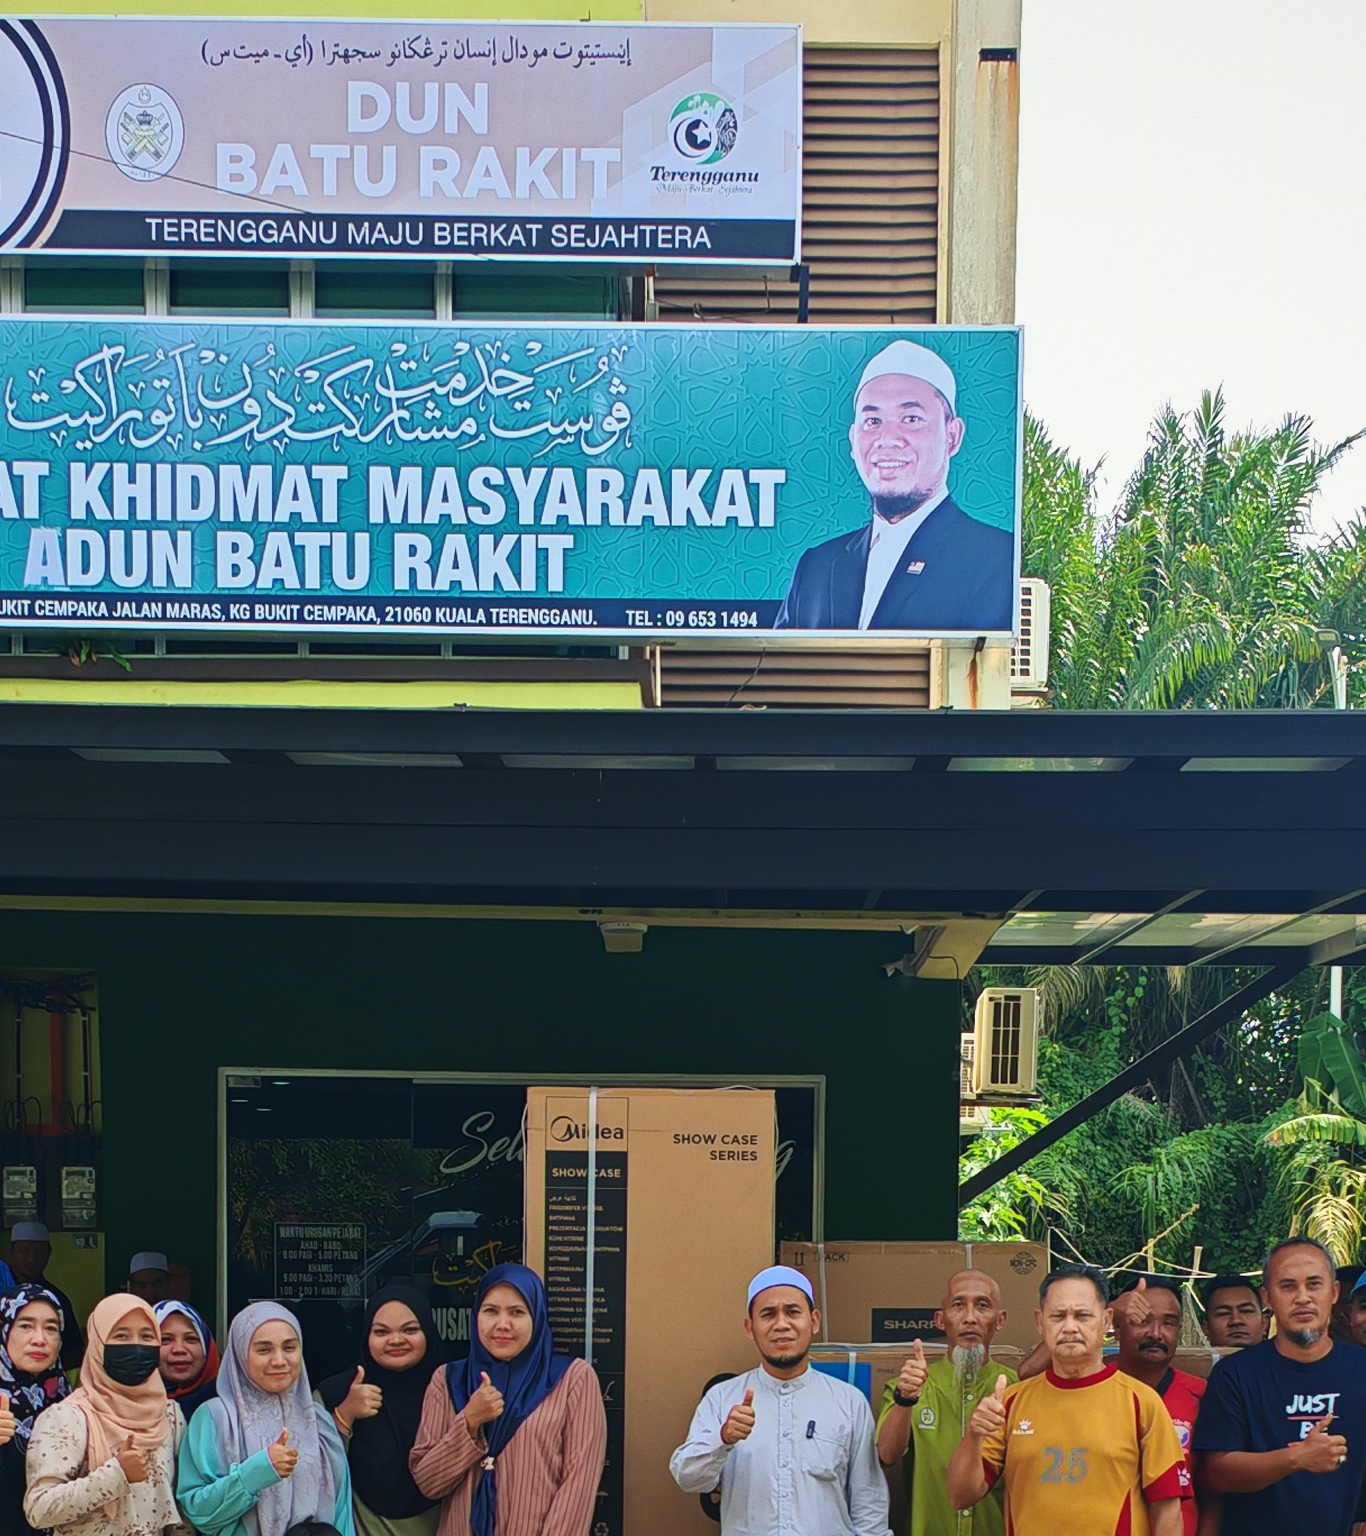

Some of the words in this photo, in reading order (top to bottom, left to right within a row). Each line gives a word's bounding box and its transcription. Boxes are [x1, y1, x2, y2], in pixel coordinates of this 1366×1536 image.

[348, 81, 489, 135] DUN
[215, 143, 399, 198] BATU
[419, 146, 622, 200] RAKIT
[650, 165, 760, 185] Terengganu
[145, 217, 337, 245] TERENGGANU
[347, 222, 425, 247] MAJU
[434, 223, 543, 248] BERKAT
[550, 224, 712, 250] SEJAHTERA
[69, 461, 349, 523] KHIDMAT
[369, 465, 786, 527] MASYARAKAT
[23, 527, 193, 588] ADUN
[215, 530, 371, 590] BATU
[393, 533, 574, 592] RAKIT
[34, 600, 109, 617] CEMPAKA
[112, 601, 163, 619] JALAN
[166, 602, 226, 621] MARAS,
[229, 603, 251, 620] KG
[254, 604, 299, 621] BUKIT
[303, 605, 381, 625] CEMPAKA,
[384, 606, 432, 624] 21060
[435, 607, 486, 625] KUALA
[490, 608, 598, 627] TERENGGANU.
[625, 610, 654, 627] TEL
[665, 610, 686, 627] 09
[688, 611, 717, 628] 653
[719, 611, 758, 628] 1494
[672, 1133, 717, 1145] SHOW
[720, 1134, 759, 1145] CASE
[709, 1150, 758, 1161] SERIES
[551, 1167, 588, 1178] SHOW
[823, 1252, 845, 1262] ACK
[432, 1307, 473, 1341] USAT
[1285, 1392, 1341, 1414] JUST
[1038, 1445, 1089, 1484] 25
